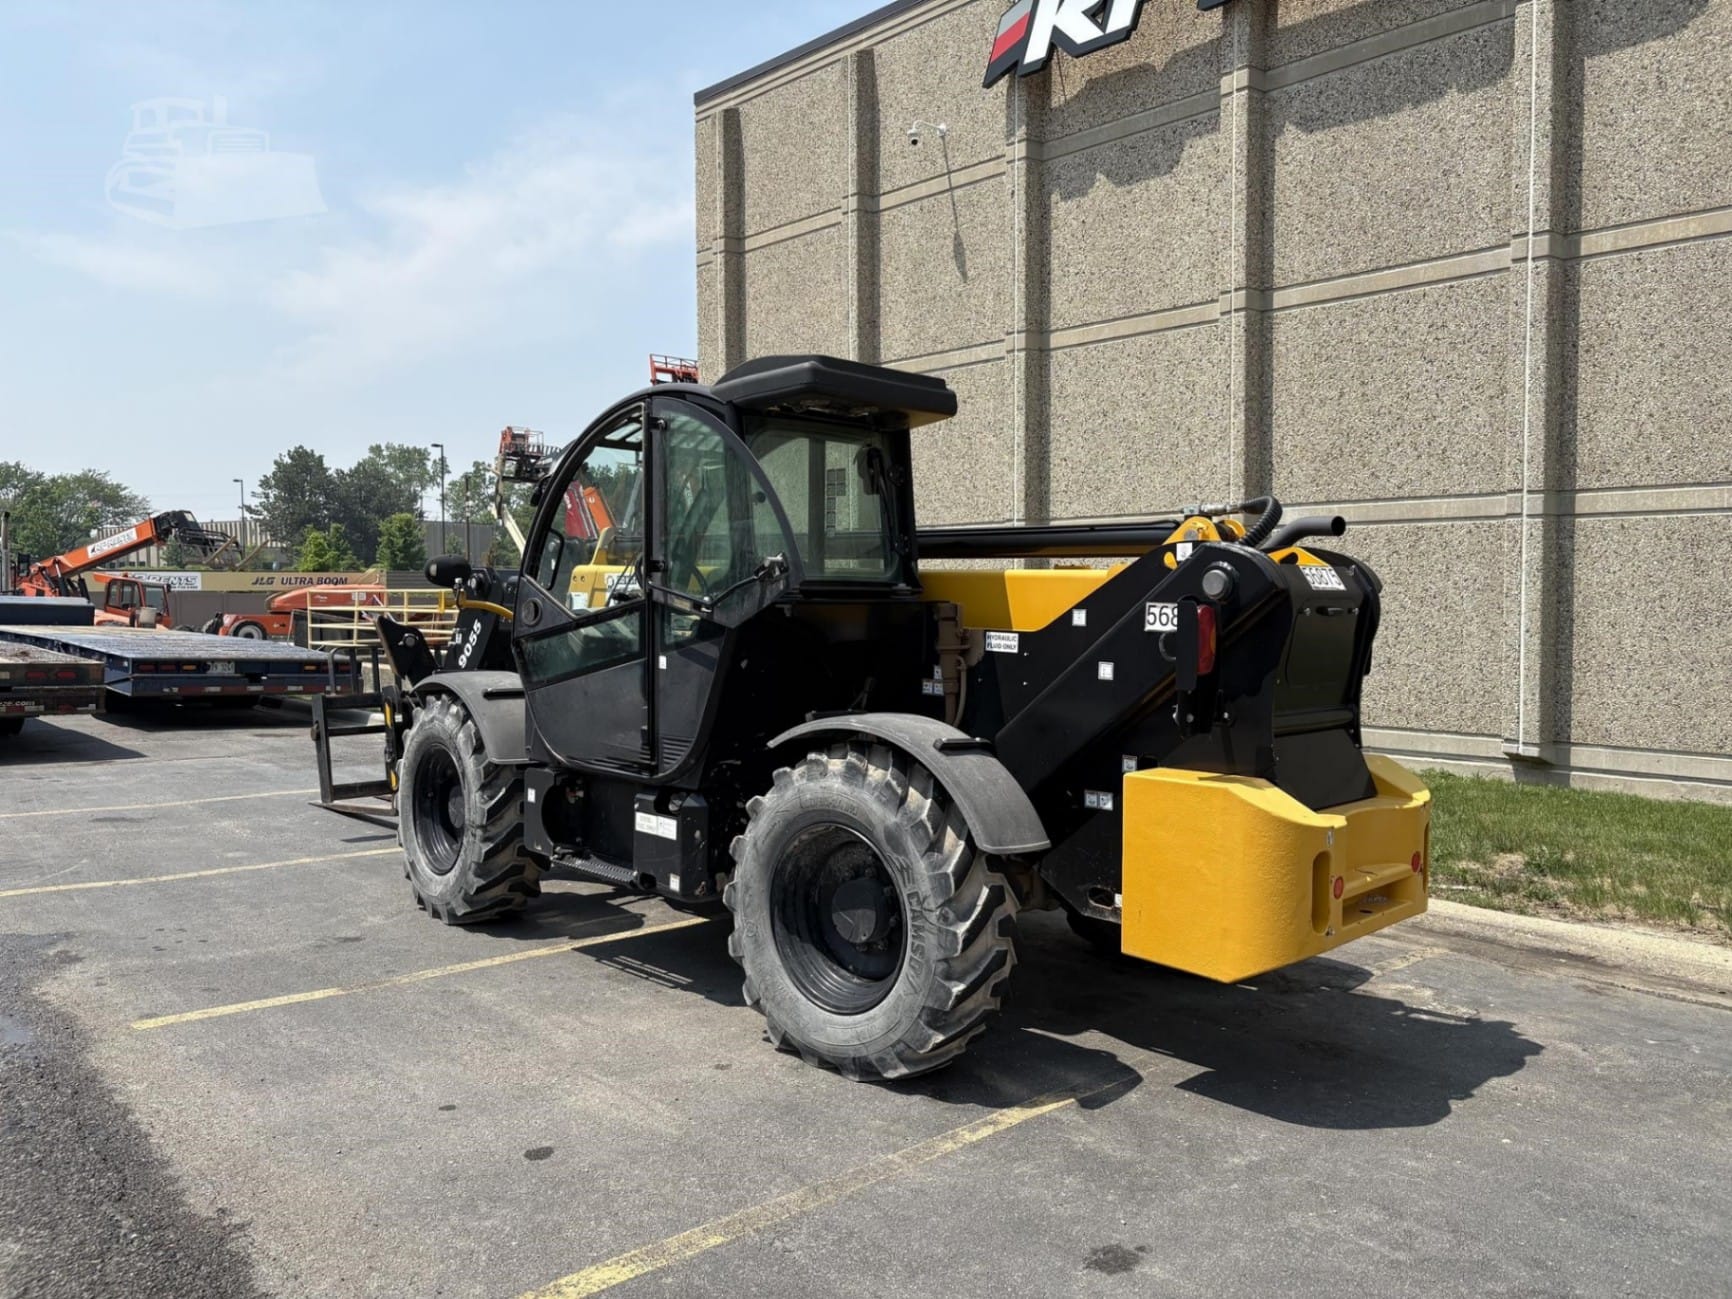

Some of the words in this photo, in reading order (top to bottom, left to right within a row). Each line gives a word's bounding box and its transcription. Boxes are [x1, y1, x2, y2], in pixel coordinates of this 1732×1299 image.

[252, 576, 276, 585] JLG
[281, 576, 314, 585] ULTRA
[317, 576, 348, 586] BOOM
[1302, 567, 1341, 586] 56875
[458, 618, 482, 669] 9055
